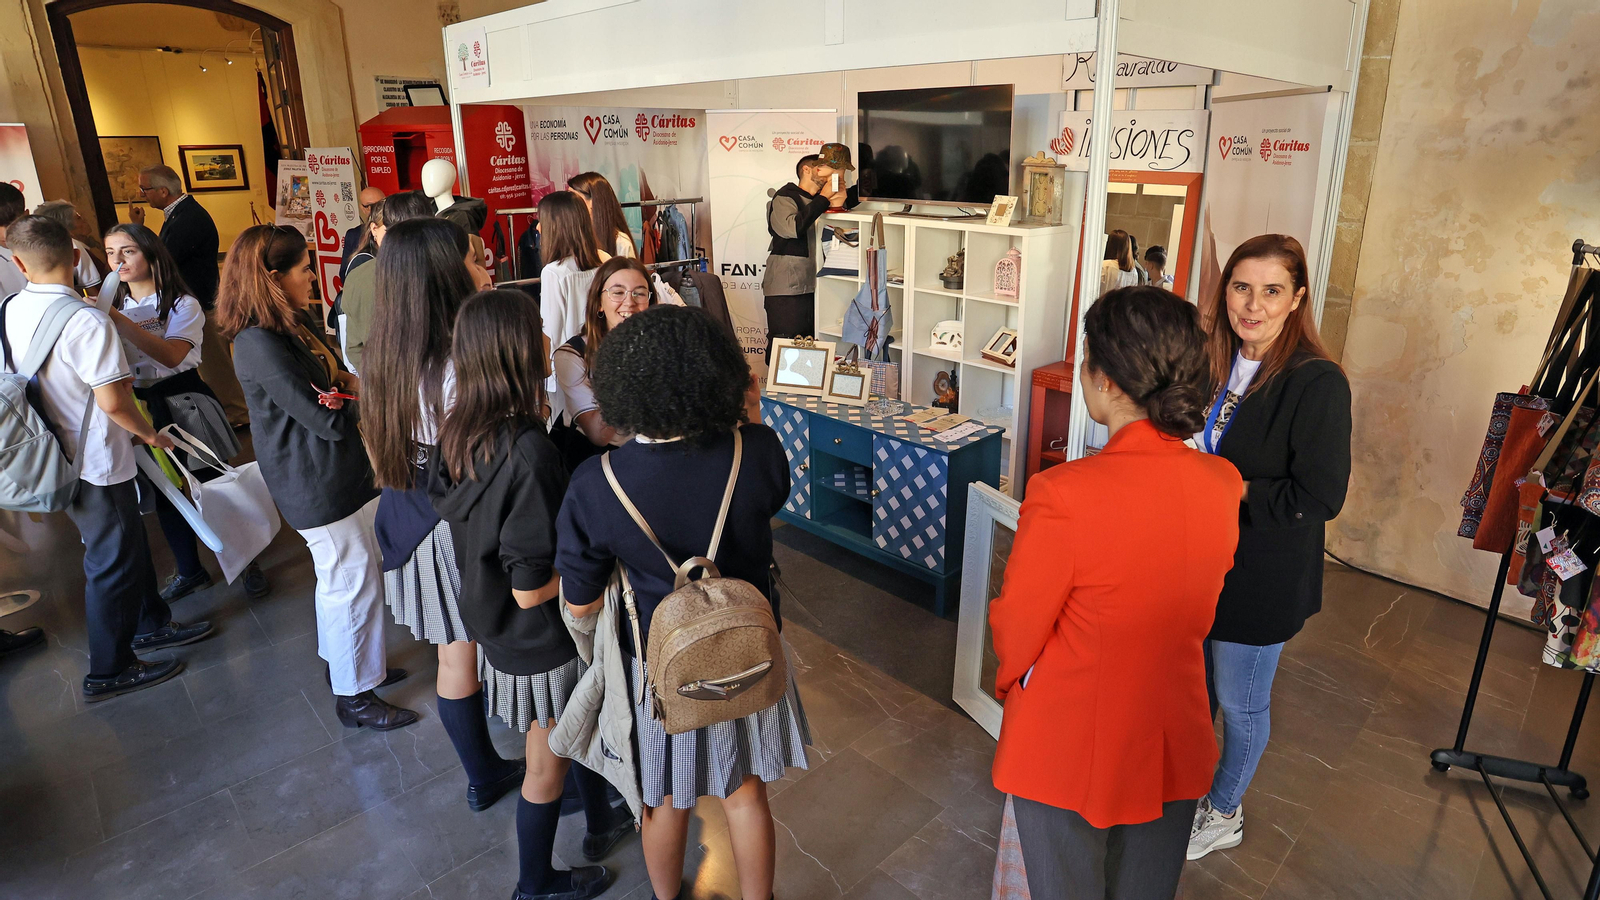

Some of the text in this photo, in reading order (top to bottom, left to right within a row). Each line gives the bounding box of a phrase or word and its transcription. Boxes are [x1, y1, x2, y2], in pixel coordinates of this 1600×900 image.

[540, 118, 566, 128] ECONOMÍA
[603, 115, 620, 124] CASA
[651, 114, 696, 128] Cáritas
[550, 132, 578, 140] PERSONAS
[604, 125, 628, 138] COMÚN
[787, 137, 824, 145] Cáritas
[1233, 136, 1247, 144] CASA
[1273, 139, 1310, 151] Cáritas
[1232, 145, 1252, 155] COMÚN
[320, 155, 350, 165] Cáritas
[490, 155, 526, 166] Cáritas
